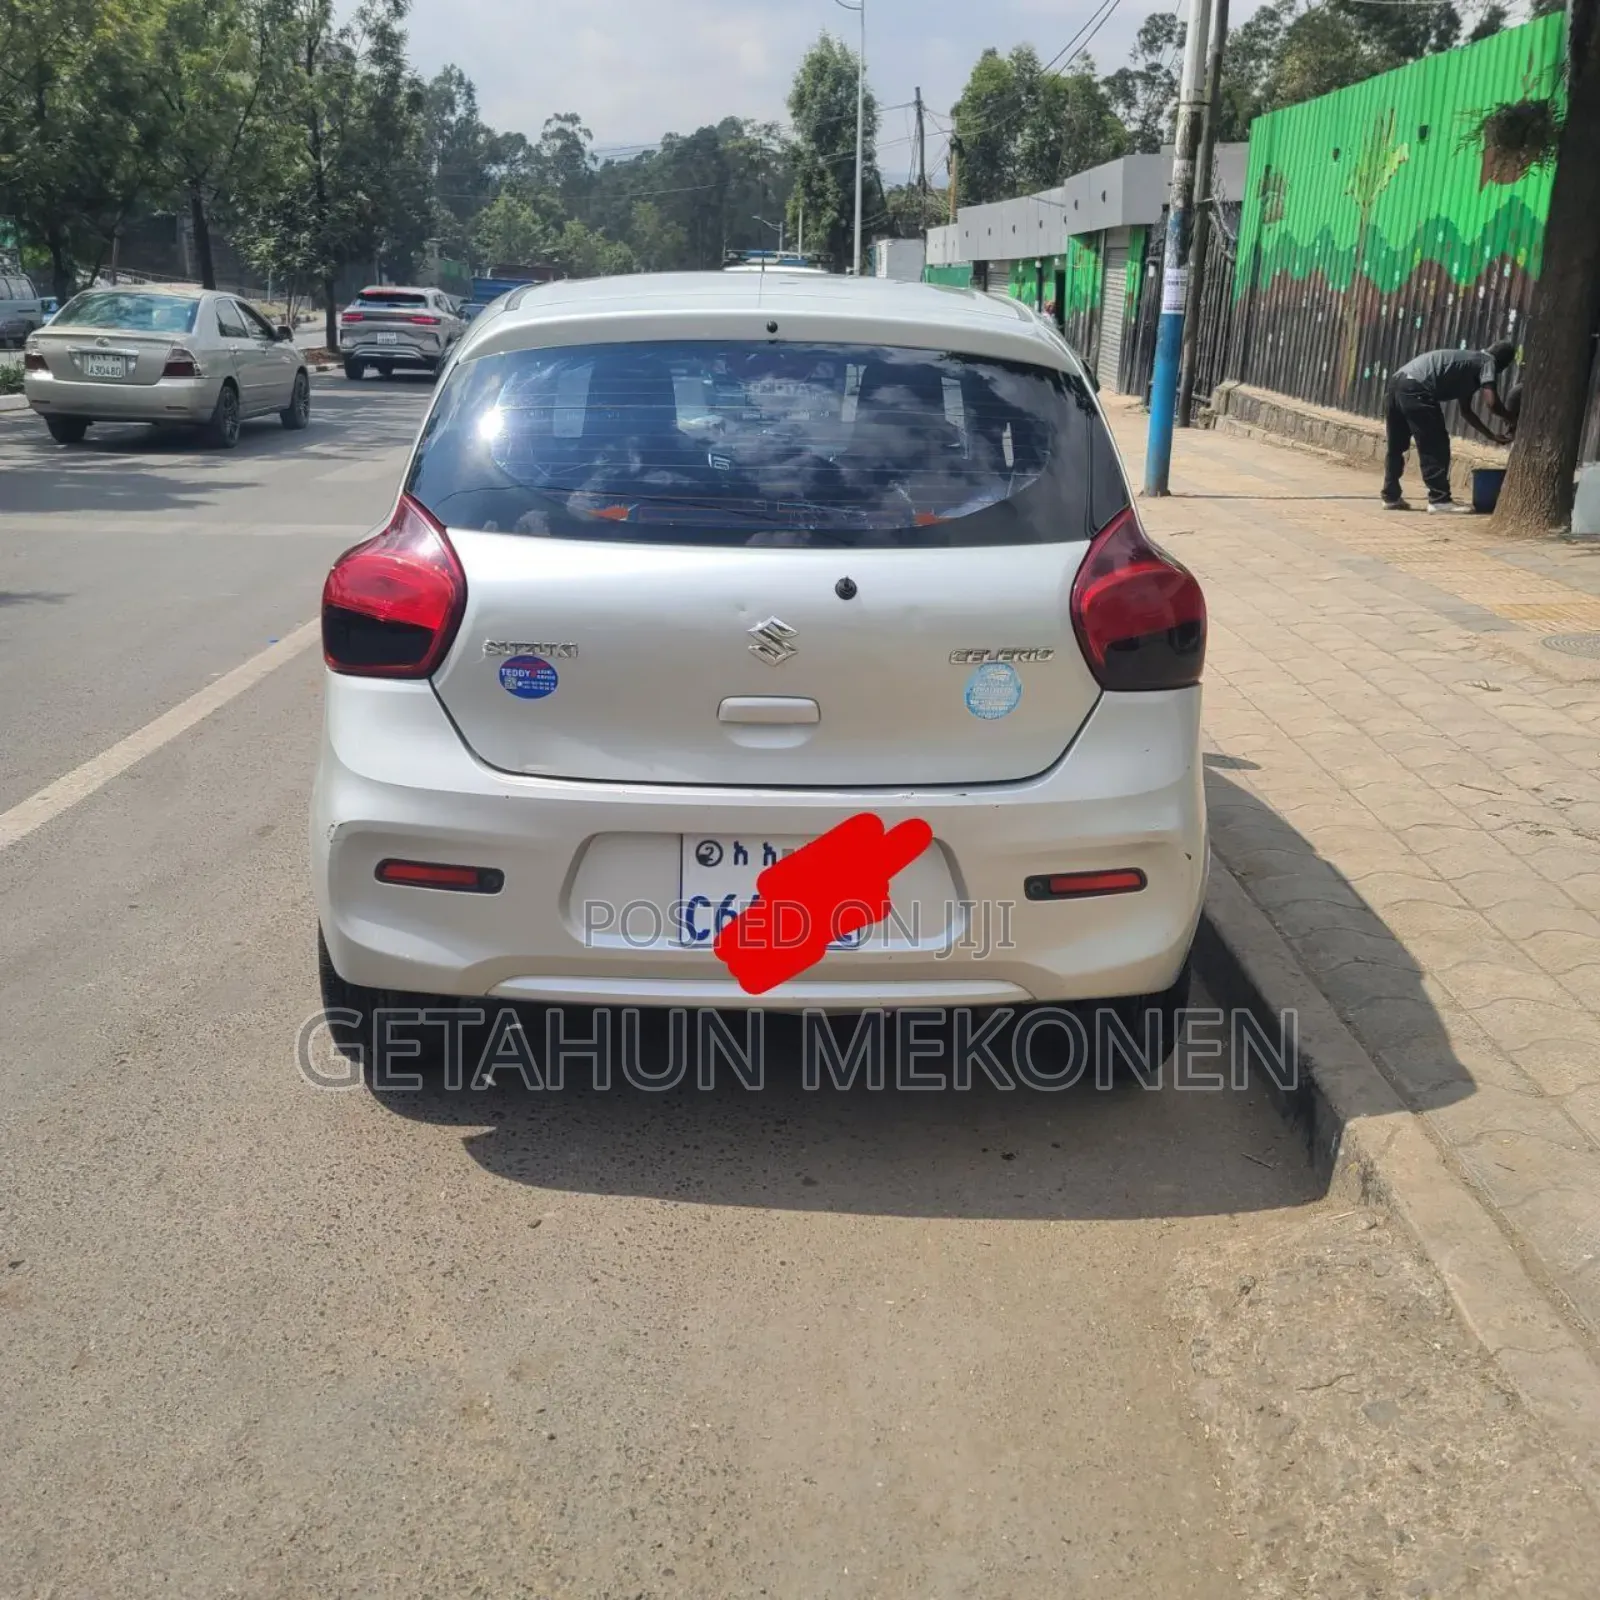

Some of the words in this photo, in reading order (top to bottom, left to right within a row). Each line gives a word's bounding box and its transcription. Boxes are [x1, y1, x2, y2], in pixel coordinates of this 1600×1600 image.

[483, 641, 579, 660] SUZUKI
[949, 648, 1054, 664] CELERIO
[501, 668, 531, 677] TEDDY
